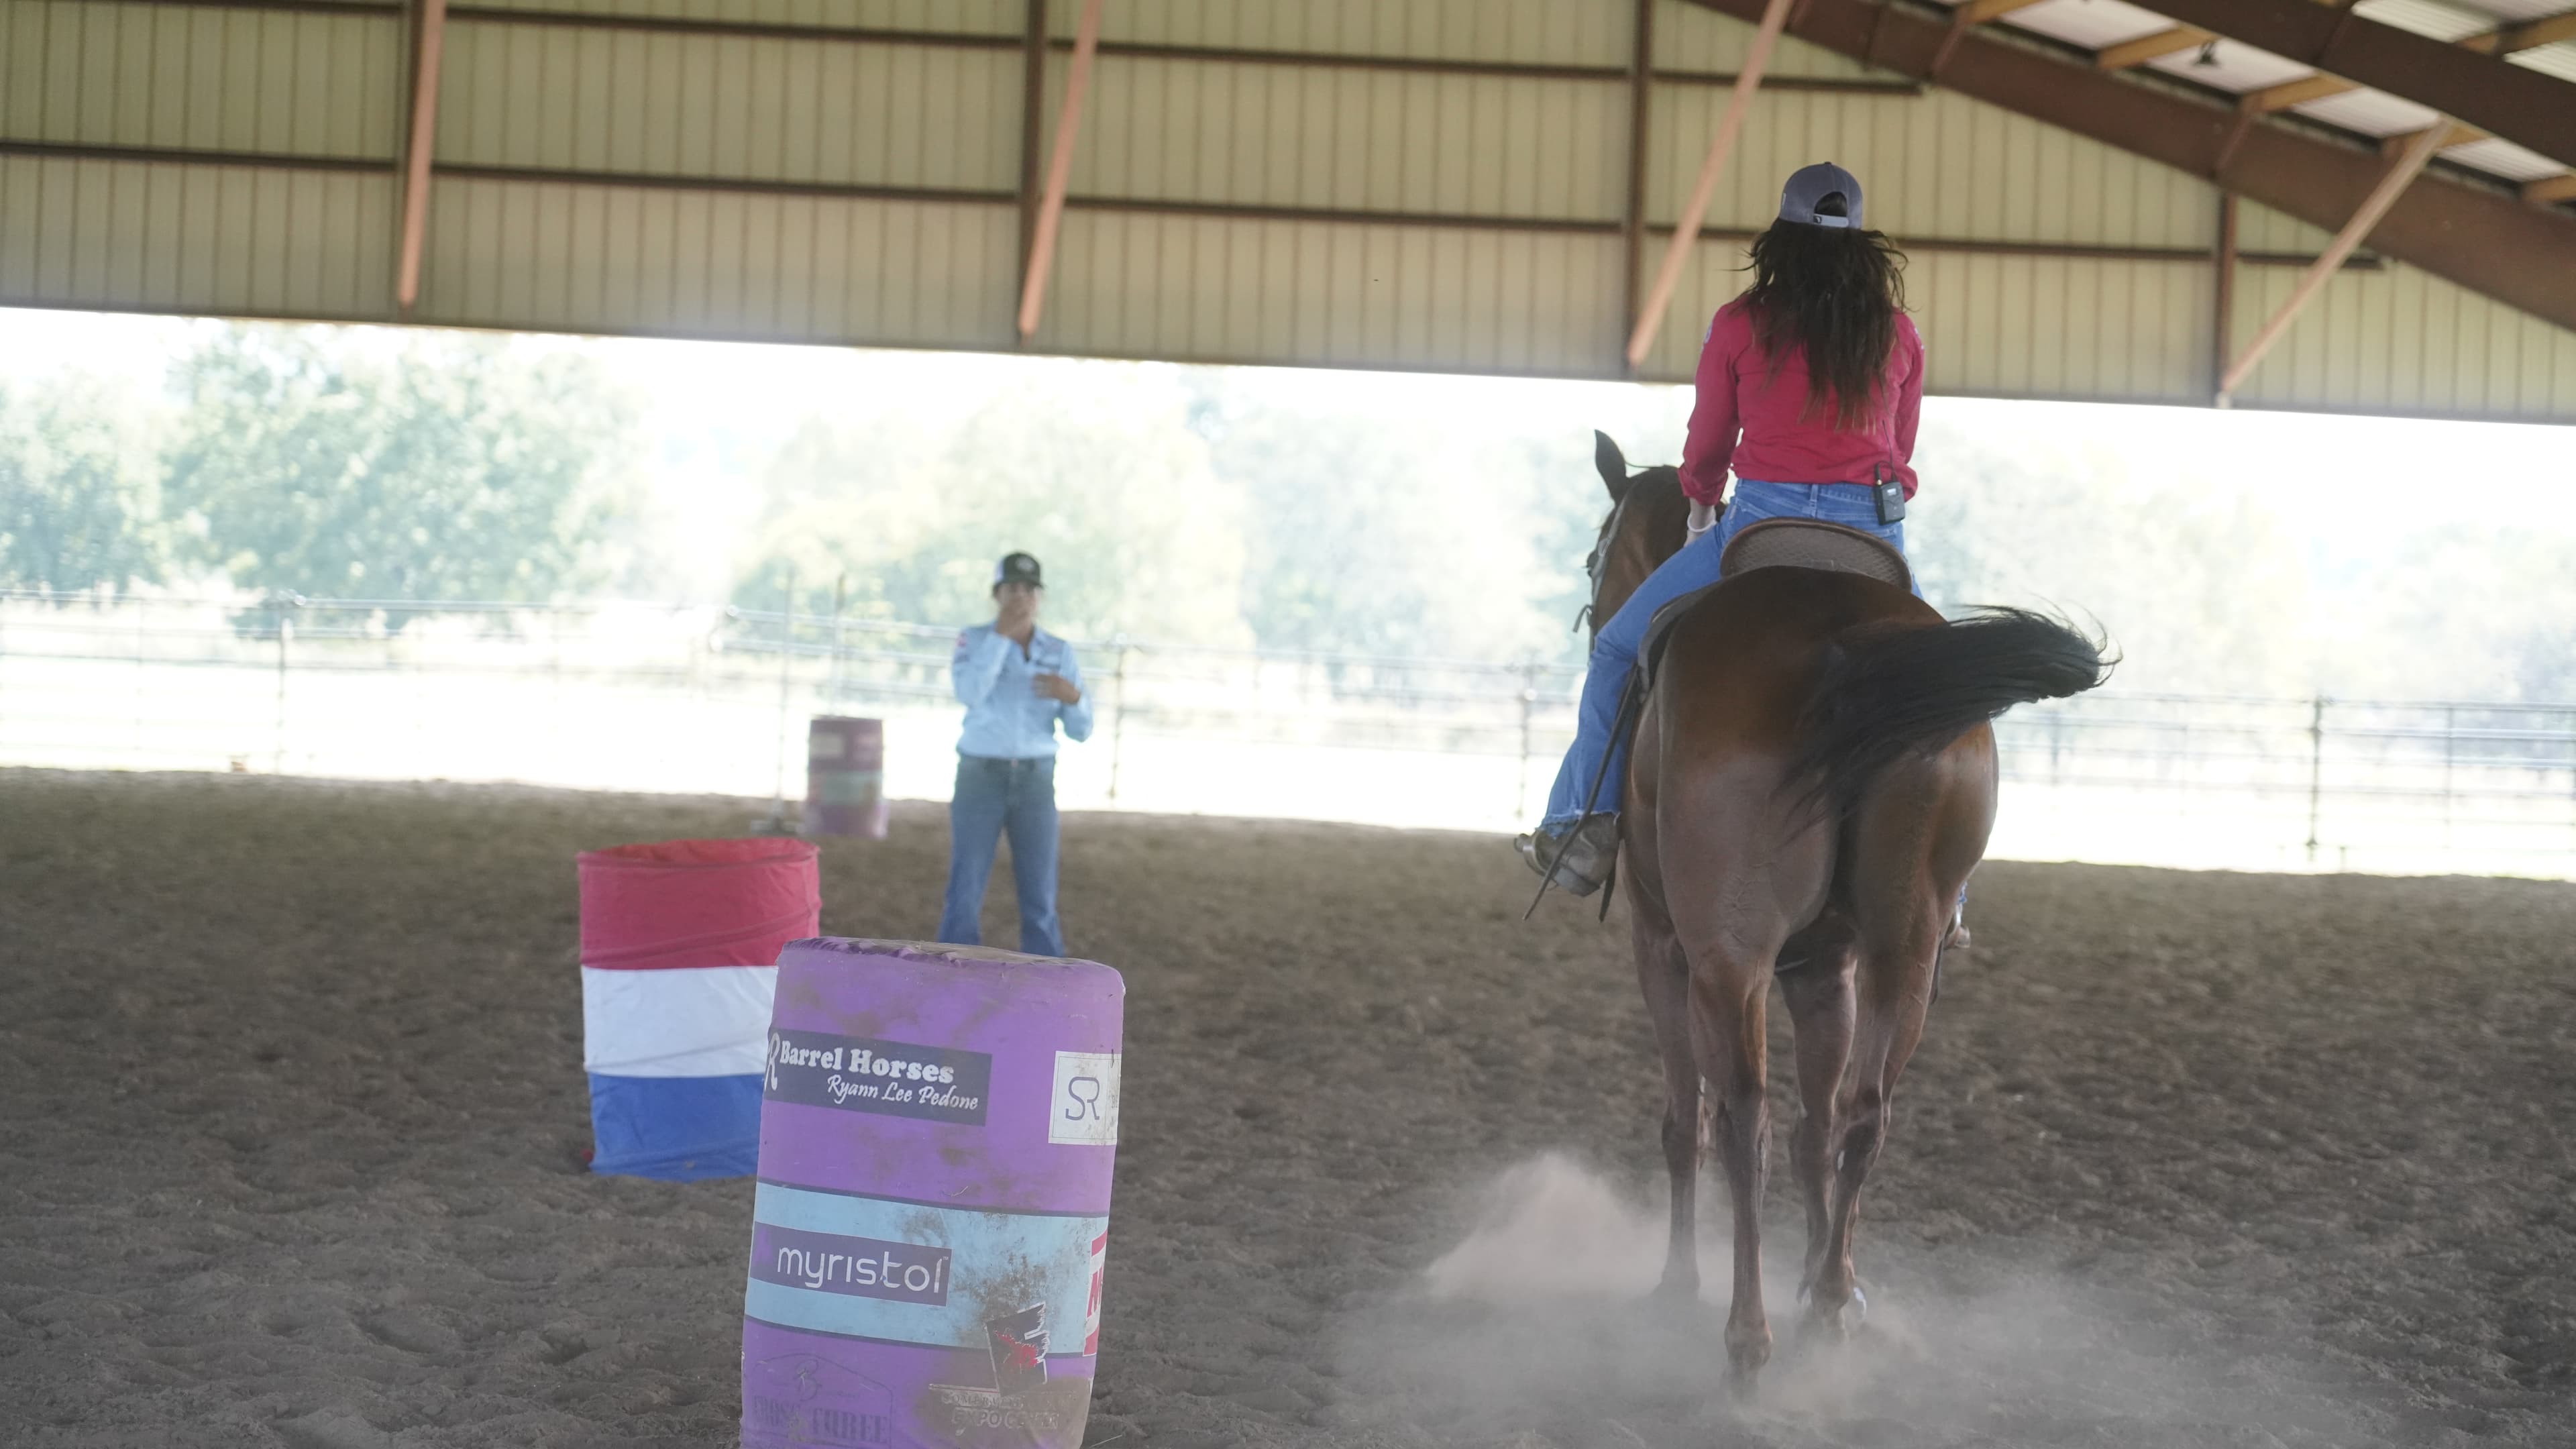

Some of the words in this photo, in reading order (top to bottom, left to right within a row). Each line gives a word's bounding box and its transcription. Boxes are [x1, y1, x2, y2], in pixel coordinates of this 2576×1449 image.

[780, 1040, 843, 1071] Barrel
[848, 1049, 955, 1083] Horses
[827, 1074, 879, 1105] Ryann
[881, 1081, 913, 1103] Lee
[918, 1085, 979, 1110] Pedone
